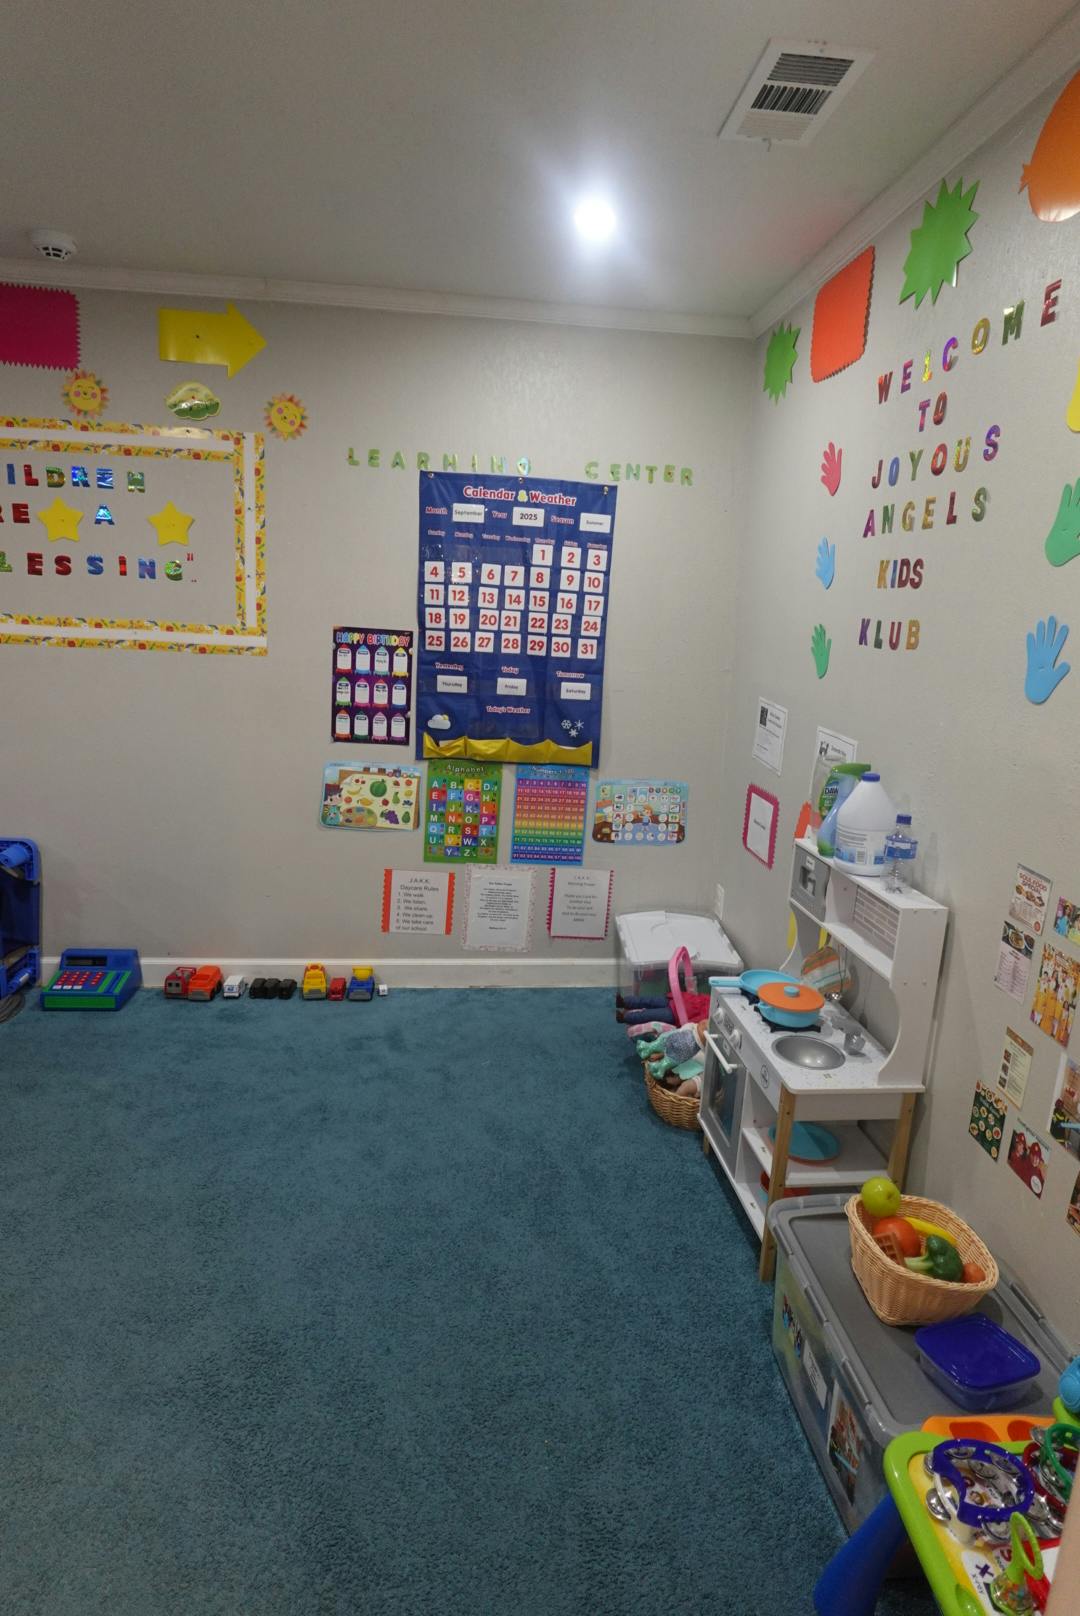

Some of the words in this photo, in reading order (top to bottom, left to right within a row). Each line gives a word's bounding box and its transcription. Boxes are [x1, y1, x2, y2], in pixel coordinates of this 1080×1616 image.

[878, 279, 1062, 404] WELCOME
[918, 392, 948, 432] TO
[346, 447, 532, 476] LEARNING
[585, 461, 694, 486] CENTER
[872, 425, 1000, 488] JOYOUS
[6, 463, 146, 493] ILDREN
[464, 486, 516, 501] Calendar
[530, 492, 576, 506] Weather
[94, 505, 115, 525] A
[519, 512, 538, 521] 2025
[863, 487, 987, 538] ANGELS
[540, 550, 545, 560] 1
[567, 551, 576, 563] 2
[594, 555, 601, 566] 3
[430, 566, 439, 577] 4
[459, 567, 465, 578] 5
[487, 569, 495, 581] 6
[511, 570, 518, 581] 7
[535, 571, 545, 583] 8
[567, 574, 574, 585] 9
[589, 576, 600, 588] 10
[877, 558, 924, 589] KIDS
[430, 589, 440, 600] 11
[452, 590, 465, 602] 12
[481, 591, 495, 603] 13
[507, 594, 523, 605] 14
[532, 595, 545, 607] 15
[561, 598, 573, 609] 16
[587, 600, 600, 610] 17
[428, 611, 443, 624] 18
[454, 612, 466, 625] 19
[481, 614, 497, 625] 20
[504, 616, 516, 627] 21
[530, 617, 545, 629] 22
[555, 618, 569, 630] 23
[583, 619, 598, 632] 24
[336, 631, 365, 645] HAPPY
[367, 633, 410, 648] BIRTHDAY
[428, 635, 443, 647] 25
[453, 636, 468, 648] 26
[478, 636, 490, 648] 27
[503, 638, 519, 650] 28
[529, 639, 545, 651] 29
[554, 642, 569, 653] 30
[581, 643, 594, 654] 31
[858, 617, 921, 651] KLUB
